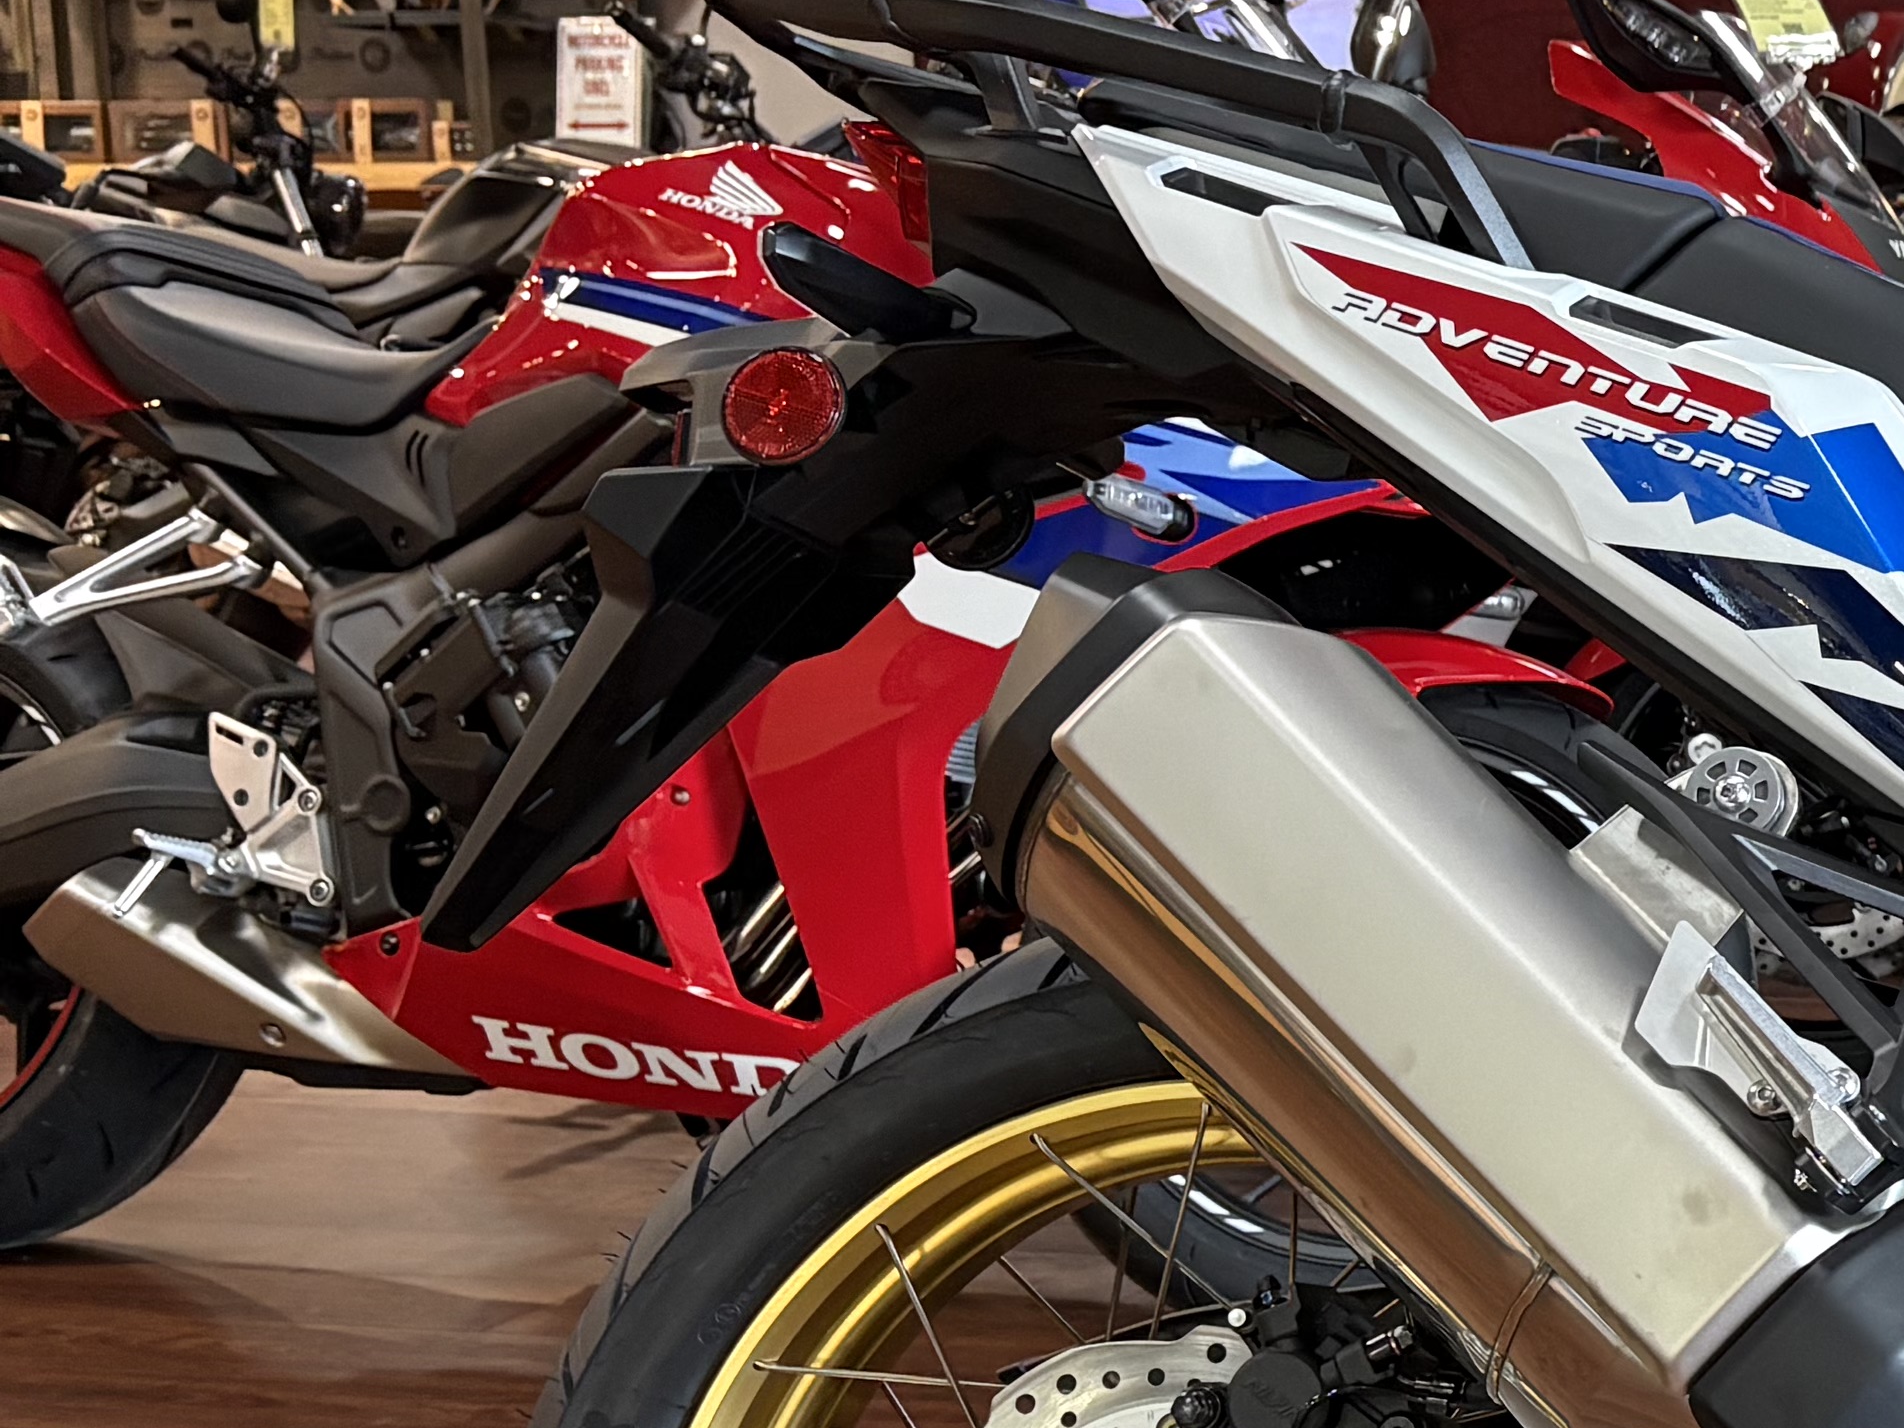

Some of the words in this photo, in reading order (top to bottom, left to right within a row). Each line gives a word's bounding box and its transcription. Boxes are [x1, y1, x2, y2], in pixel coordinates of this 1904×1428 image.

[658, 188, 754, 230] HONDA
[1331, 291, 1782, 450] ADVENTURE
[1574, 415, 1812, 500] SPORTS
[472, 1015, 800, 1096] HOND
